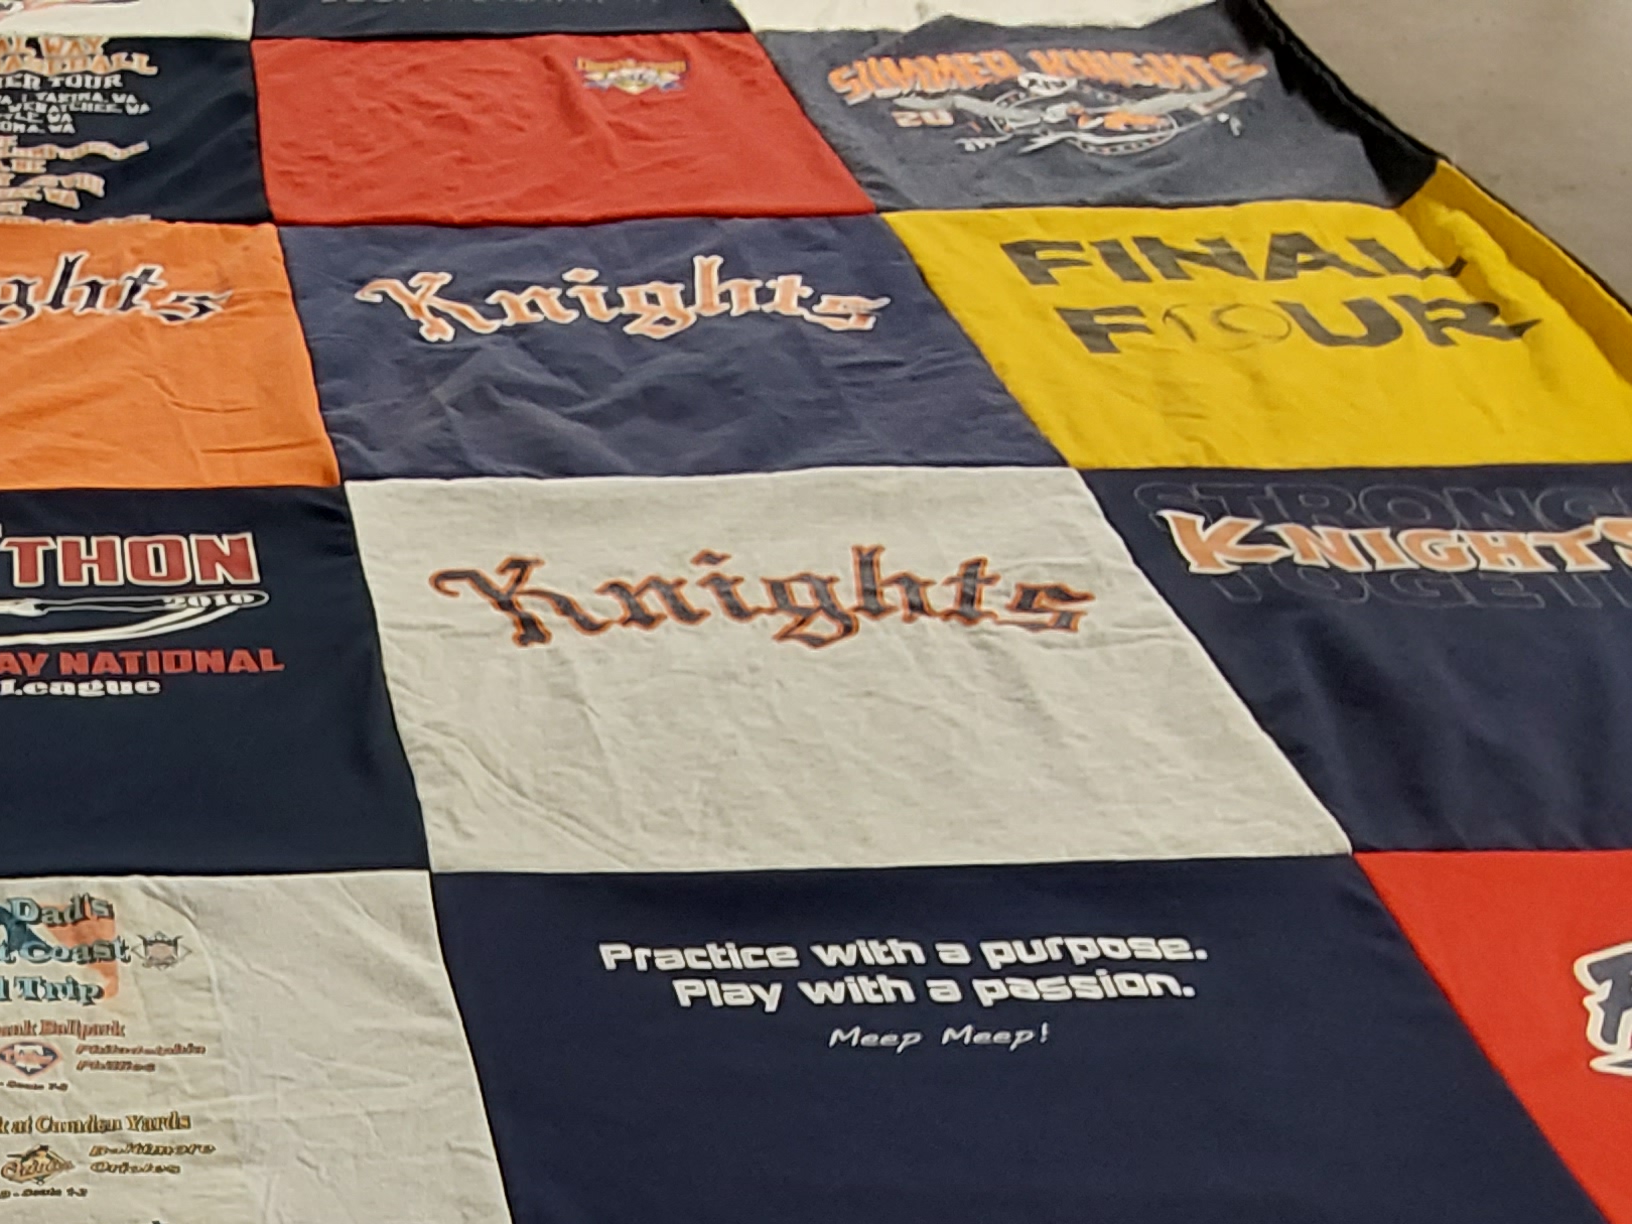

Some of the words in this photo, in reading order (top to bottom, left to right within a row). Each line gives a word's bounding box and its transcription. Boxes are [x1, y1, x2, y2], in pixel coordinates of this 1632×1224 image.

[39, 36, 108, 56] WAY
[48, 73, 124, 89] TOUR
[828, 49, 1025, 105] SUMMER
[1028, 49, 1267, 91] KNIGHTS
[999, 231, 1468, 286] FINAL
[355, 254, 890, 342] Knights
[1055, 293, 1542, 355] FOUR
[428, 544, 1096, 648] Knights
[58, 647, 286, 677] NATIONAL
[7, 892, 115, 925] Dad's
[19, 934, 133, 966] Coast
[599, 942, 801, 971] Practice
[810, 938, 926, 968] with
[934, 942, 971, 966] a
[979, 935, 1209, 968] purpose.
[14, 976, 106, 1008] Trip
[671, 976, 783, 1013] Play
[798, 973, 918, 1005] with
[925, 978, 964, 1003] a
[971, 967, 1197, 1007] passion.
[39, 1018, 127, 1041] Ballpark
[827, 1025, 923, 1054] Meep
[939, 1022, 1051, 1053] Meep!
[10, 1114, 33, 1134] at
[35, 1114, 123, 1134] Camden
[125, 1111, 193, 1133] Yards
